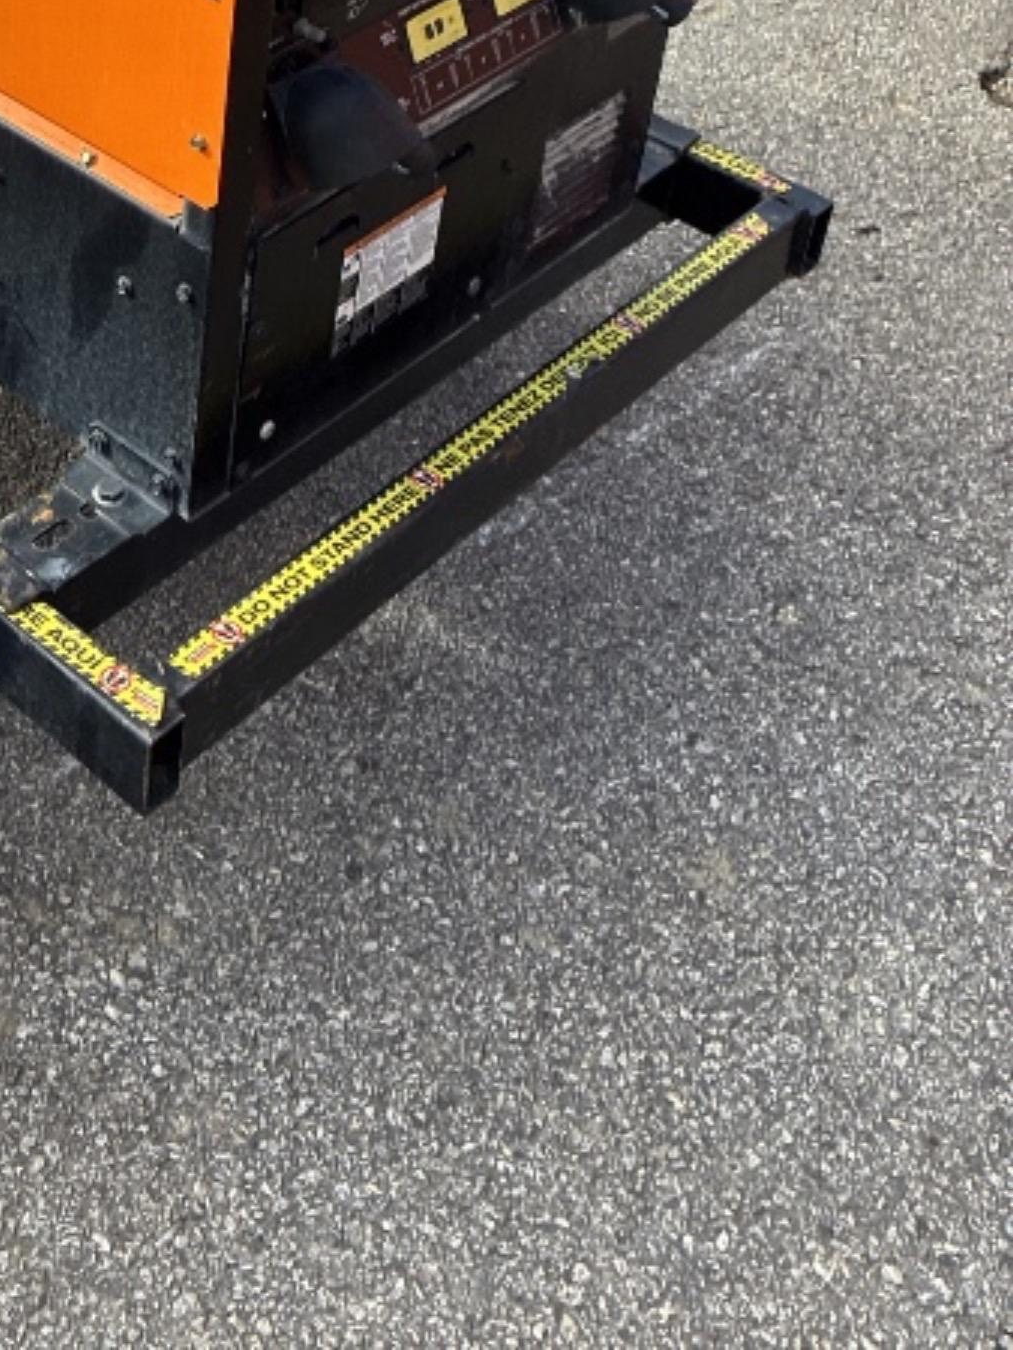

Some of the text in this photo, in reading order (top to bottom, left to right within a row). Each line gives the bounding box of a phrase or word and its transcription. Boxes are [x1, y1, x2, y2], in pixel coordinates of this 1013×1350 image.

[237, 596, 271, 625] DO
[268, 564, 313, 602] NOT
[307, 517, 374, 571] STAND
[46, 623, 102, 672] AQUI
